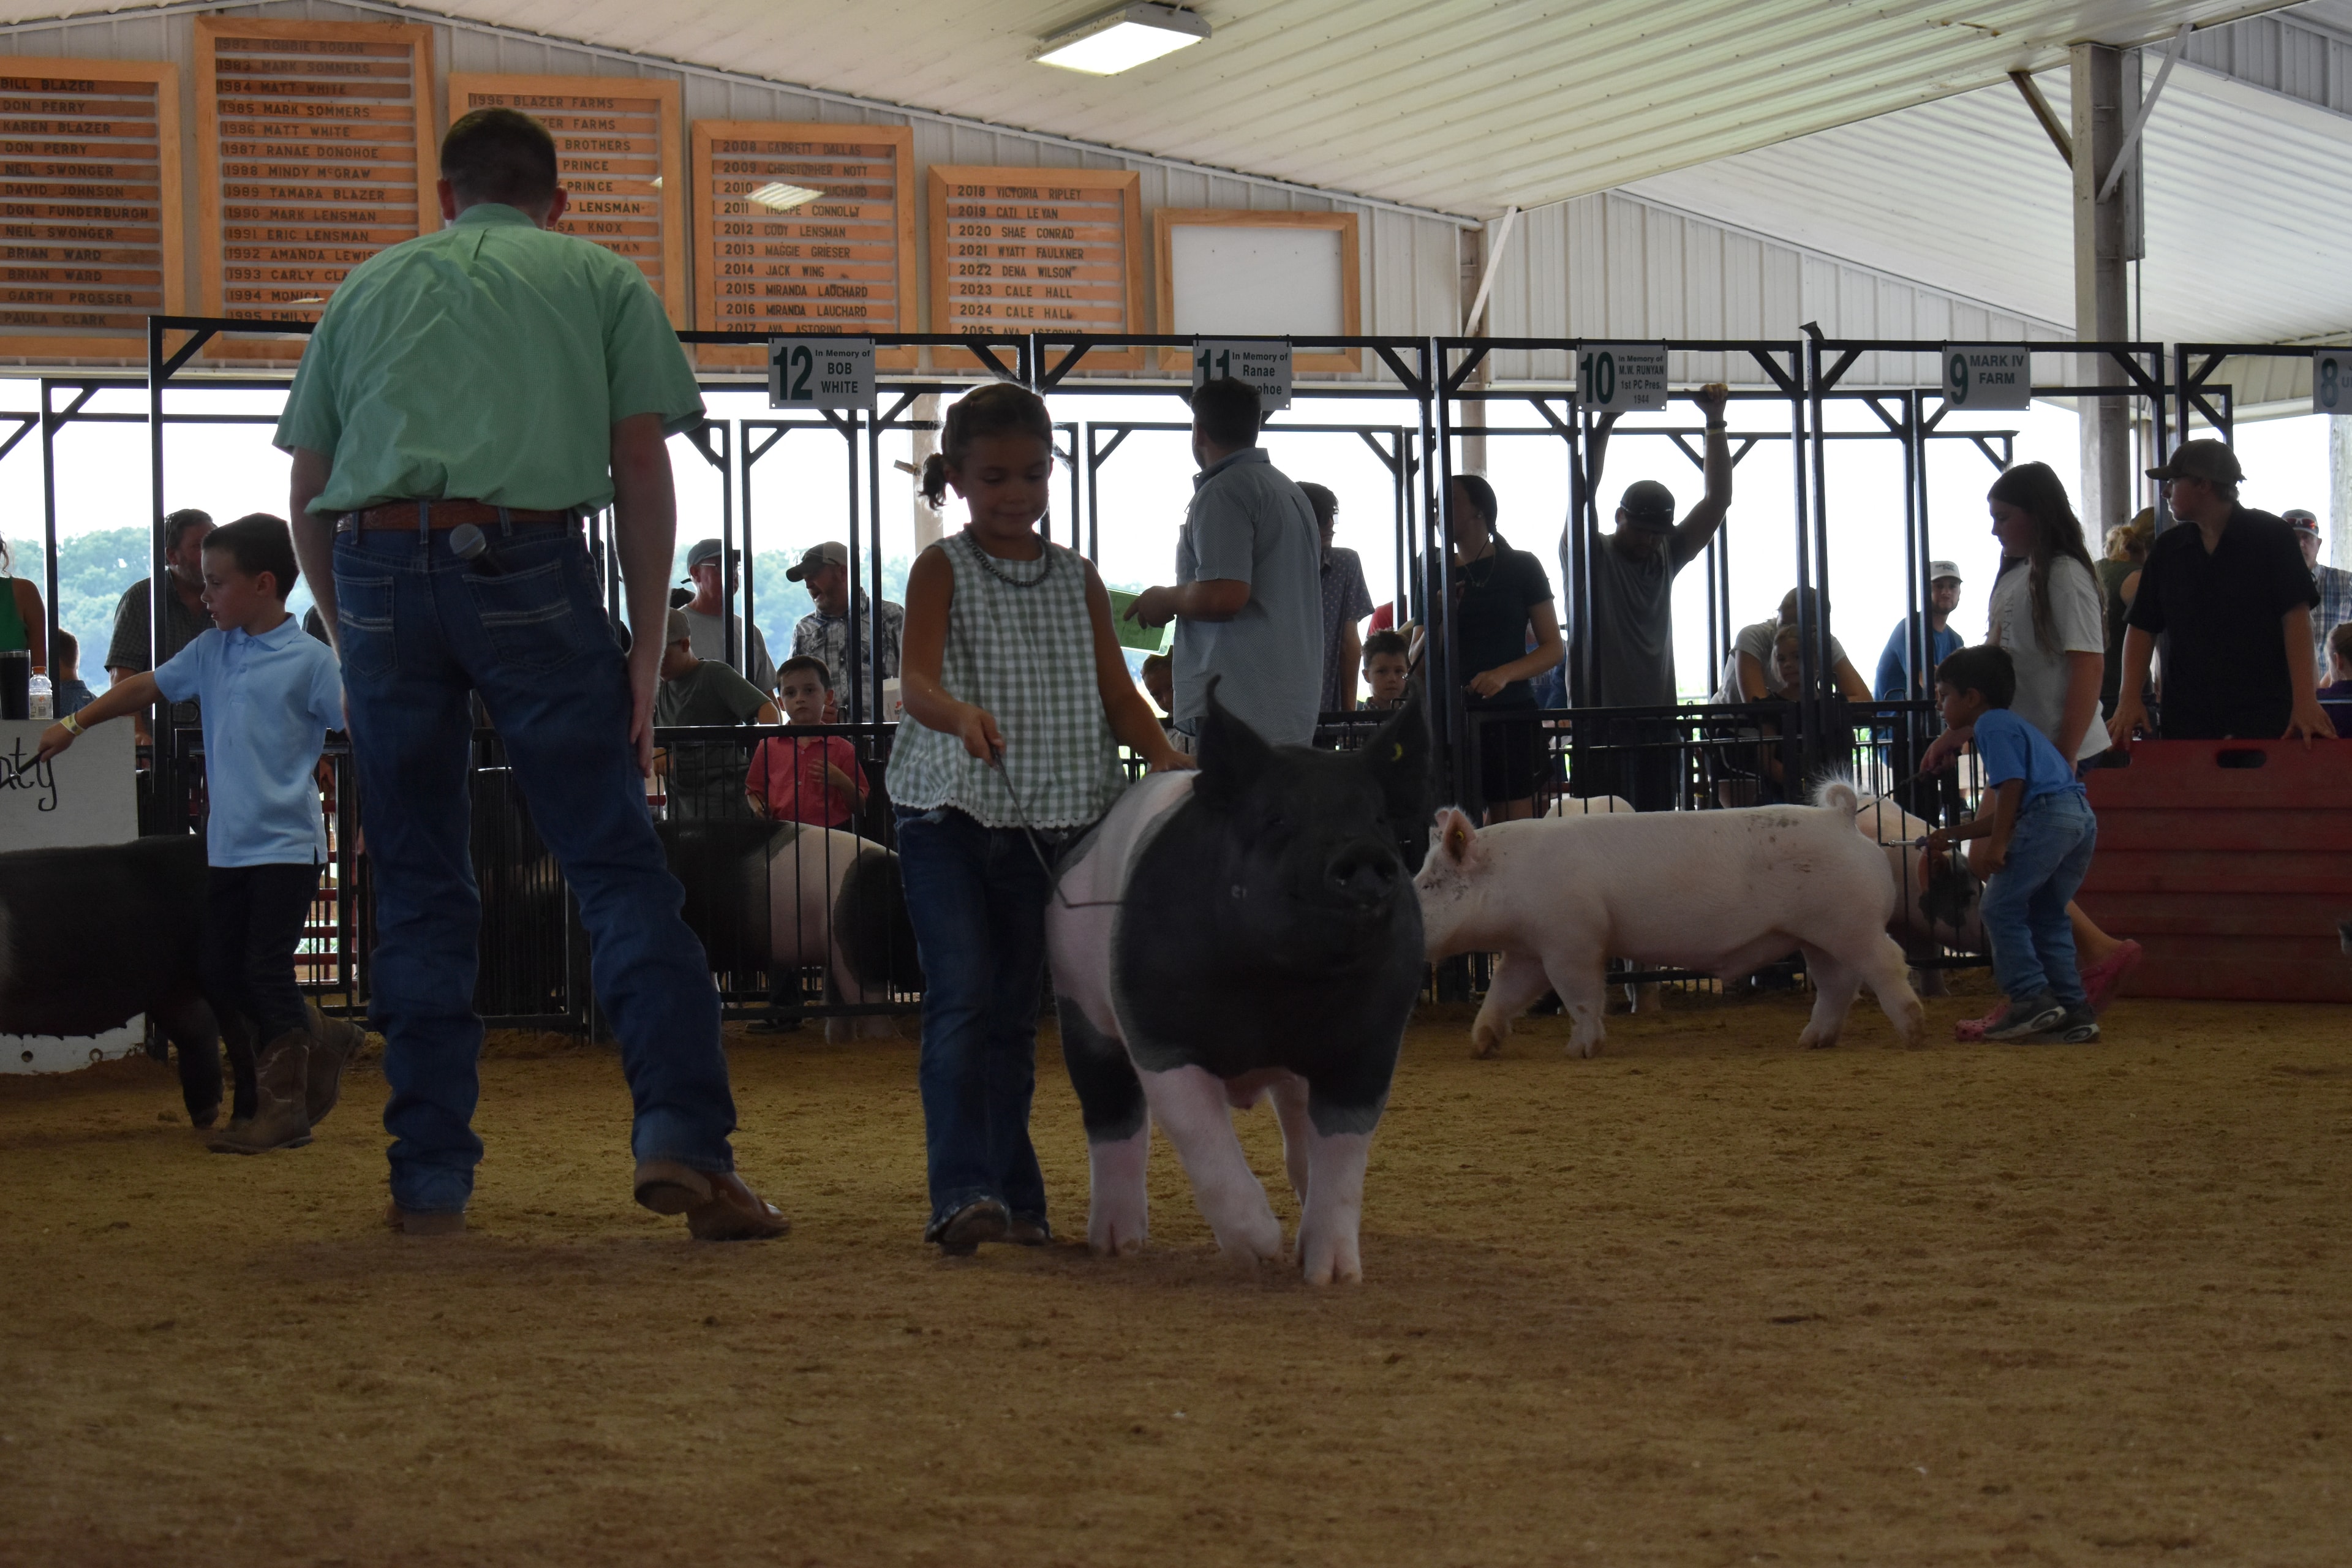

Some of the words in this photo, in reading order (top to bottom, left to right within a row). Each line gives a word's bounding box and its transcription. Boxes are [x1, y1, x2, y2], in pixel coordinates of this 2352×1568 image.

[320, 42, 364, 53] ROGAN
[219, 60, 251, 70] 1983
[262, 61, 297, 72] MARK
[307, 62, 371, 74] SOMMERS
[1, 79, 30, 90] BILL
[42, 80, 95, 92] BLAZER
[219, 81, 252, 92] 1984
[260, 82, 296, 93] MATT
[306, 83, 346, 94] WHITE
[4, 100, 31, 111] DON
[42, 102, 85, 112] PERRY
[473, 95, 503, 105] 1996
[513, 96, 564, 107] BLAZER
[572, 99, 614, 109] FARMS
[223, 104, 254, 114] 1985
[263, 104, 299, 115] MARK
[307, 105, 371, 118] SOMMERS
[4, 121, 47, 132] KAREN
[58, 123, 111, 134] BLAZER
[225, 124, 255, 134] 1986
[264, 125, 300, 136] MATT
[310, 127, 350, 137] WHITE
[573, 119, 616, 130] FARMS
[6, 142, 33, 153] DON
[44, 143, 88, 154] PERRY
[565, 140, 631, 151] BROTHERS
[723, 141, 756, 152] 2008
[767, 142, 812, 154] GARRETT
[824, 144, 861, 156] DALLAS
[225, 145, 256, 154] 1987
[266, 145, 309, 157] RANAE
[317, 146, 379, 159] DONOHOE
[6, 164, 35, 176] NEIL
[47, 165, 114, 176] SWONGER
[227, 165, 258, 175] 1988
[269, 166, 310, 176] MINDY
[563, 160, 609, 171] PRINCE
[723, 162, 756, 173] 2009
[767, 164, 833, 176] CHRISTOPHER
[843, 165, 867, 176] NOTT
[6, 185, 47, 195] DAVID
[61, 186, 123, 197] JOHNSON
[227, 186, 259, 197] 1989
[270, 187, 323, 199] TAMARA
[333, 189, 385, 200] BLAZER
[567, 182, 612, 192] PRINCE
[725, 182, 753, 193] 2010
[958, 185, 986, 197] 2018
[997, 186, 1038, 199] VICTORIA
[1049, 189, 1082, 200] RIPLEY
[7, 205, 34, 215] DON
[49, 206, 148, 219] FUNDERBURGH
[579, 202, 640, 213] LENSMAN
[725, 202, 749, 214] 2011
[812, 205, 859, 217] CONNOLLY
[959, 206, 986, 216] 2019
[997, 207, 1017, 218] CATI
[228, 208, 260, 219] 1990
[270, 208, 305, 220] MARK
[314, 210, 376, 222] LENSMAN
[6, 226, 36, 237] NEIL
[48, 227, 113, 239] SWONGER
[588, 223, 622, 233] KNOX
[725, 224, 753, 235] 2012
[764, 225, 788, 236] CODY
[800, 226, 846, 238] LENSMAN
[959, 225, 991, 236] 2020
[1002, 227, 1026, 238] SHAE
[1036, 228, 1074, 239] CONRAD
[229, 228, 257, 239] 1991
[267, 230, 297, 239] ERIC
[307, 230, 368, 243] LENSMAN
[7, 248, 48, 258] BRIAN
[64, 249, 101, 260] WARD
[228, 249, 260, 259] 1992
[270, 249, 325, 260] AMANDA
[725, 244, 755, 255] 2013
[765, 246, 800, 257] MAGGIE
[811, 247, 850, 258] GRIESER
[959, 245, 987, 255] 2021
[998, 246, 1026, 257] WYATT
[1036, 247, 1084, 260] FAULKNER
[8, 270, 49, 280] BRIAN
[64, 271, 102, 281] WARD
[229, 269, 261, 279] 1993
[271, 270, 314, 281] CARLY
[725, 263, 754, 274] 2014
[766, 265, 790, 276] JACK
[802, 266, 824, 277] WING
[960, 264, 992, 276] 2022
[1002, 266, 1027, 277] DENA
[1038, 266, 1072, 278] WILSON
[230, 290, 262, 301] 1994
[272, 291, 321, 301] MONICA
[726, 283, 755, 295] 2015
[766, 284, 807, 296] MIRANDA
[818, 285, 868, 298] LAUCHARD
[960, 284, 992, 295] 2023
[1005, 286, 1032, 297] CALE
[1046, 287, 1072, 298] HALL
[9, 292, 53, 301] GARTH
[70, 293, 132, 304] PROSSER
[230, 311, 262, 320] 1995
[271, 312, 311, 322] EMILY
[726, 304, 755, 314] 2016
[766, 304, 806, 316] MIRANDA
[817, 306, 867, 317] LAUCHARD
[960, 304, 992, 315] 2024
[1006, 306, 1034, 318] CALE
[1044, 307, 1072, 319] HALL
[5, 313, 48, 323] PAULA
[62, 315, 107, 325] CLARK
[727, 323, 756, 333] 2017
[826, 350, 859, 358] Memory
[1243, 352, 1277, 363] Memory
[1197, 349, 1230, 383] 11
[1970, 355, 2008, 366] MARK
[2013, 355, 2024, 366] IV
[773, 345, 813, 400] 12
[827, 363, 852, 374] BOB
[1243, 364, 1275, 376] Ranae
[1619, 366, 1634, 375] M.W.
[1637, 366, 1664, 375] RUNYAN
[1580, 352, 1615, 405] 10
[1950, 353, 1968, 405] 9
[1979, 373, 2015, 384] FARM
[2320, 358, 2339, 407] 8
[821, 381, 858, 393] WHITE
[1621, 380, 1631, 390] 1st
[1634, 380, 1642, 390] PC
[1645, 380, 1662, 390] Pres.
[1634, 395, 1649, 404] 1944
